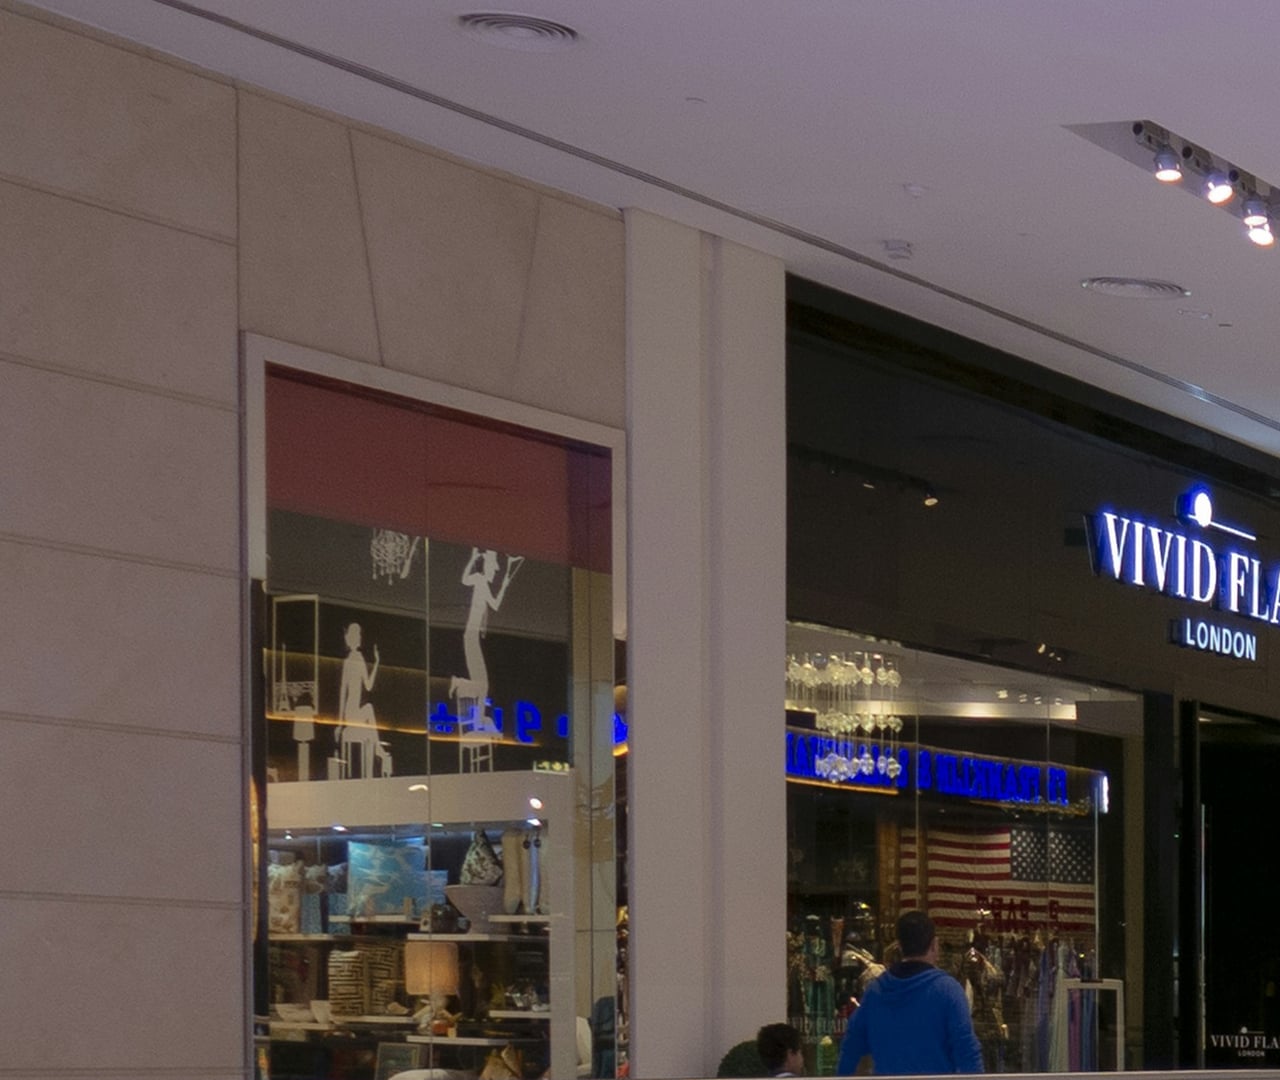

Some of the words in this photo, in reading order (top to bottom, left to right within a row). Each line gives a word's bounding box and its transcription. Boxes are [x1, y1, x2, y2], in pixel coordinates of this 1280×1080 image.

[1102, 511, 1219, 604] VIVID
[1185, 617, 1257, 661] LONDON
[1210, 1034, 1250, 1049] VIVID
